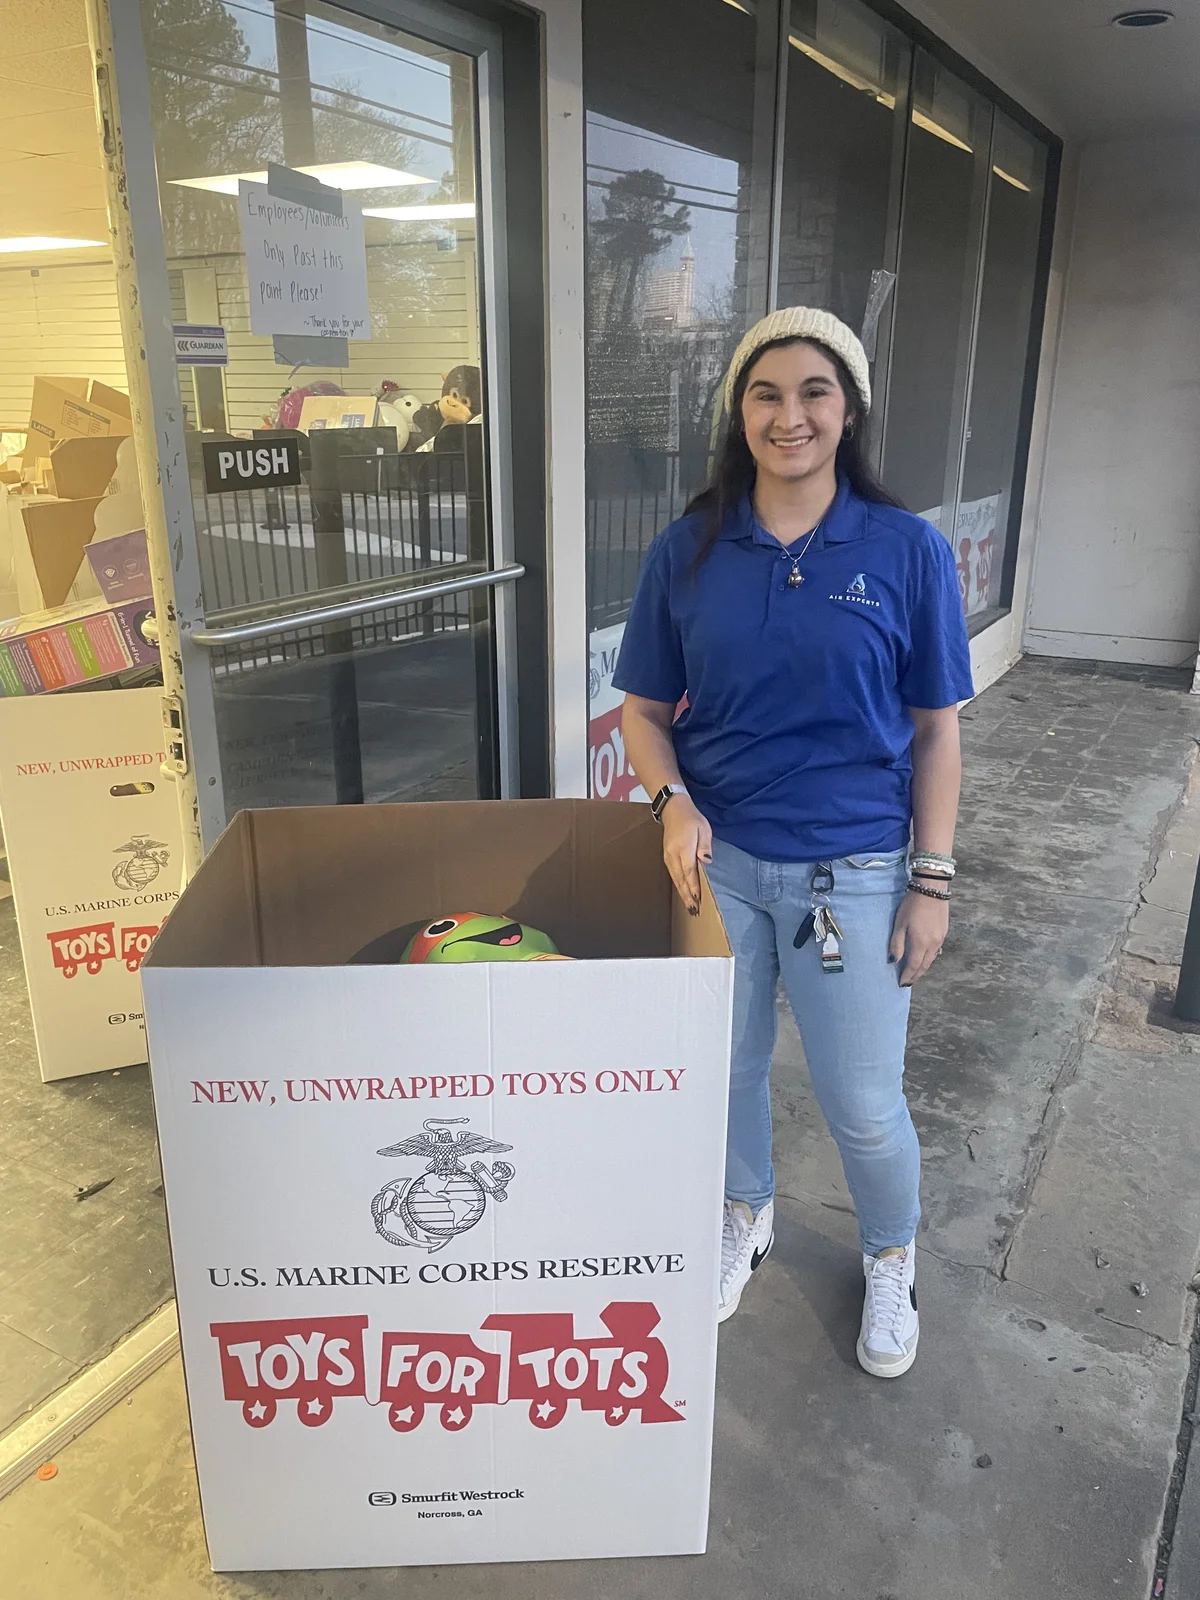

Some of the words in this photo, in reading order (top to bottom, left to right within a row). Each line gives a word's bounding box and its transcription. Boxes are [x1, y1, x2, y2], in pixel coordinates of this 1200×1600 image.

[264, 240, 285, 268] Only
[293, 244, 317, 267] Past
[323, 249, 343, 270] this
[290, 281, 323, 303] Please!
[328, 319, 339, 329] you
[342, 315, 350, 328] for
[218, 447, 290, 480] PUSH
[846, 595, 880, 607] EXPERTS
[16, 761, 56, 776] NEW,
[59, 752, 153, 773] UNWRAPPED
[45, 905, 71, 917] U.S.
[74, 897, 131, 914] MARINE
[134, 890, 180, 906] CORPS
[55, 931, 111, 961] TOYS
[124, 931, 156, 953] FO
[190, 1079, 276, 1106] NEW,
[283, 1074, 495, 1102] UNWRAPPED
[502, 1071, 587, 1096] TOYS
[595, 1068, 686, 1093] ONLY
[206, 1267, 267, 1287] U.S.
[275, 1264, 411, 1287] MARINE
[418, 1260, 529, 1284] CORPS
[537, 1253, 686, 1279] RESERVE
[226, 1331, 355, 1390] TOYS
[386, 1344, 486, 1397] FOR
[518, 1346, 649, 1399] TOTS
[401, 1491, 458, 1504] Smurfit
[459, 1488, 525, 1501] Westrock
[417, 1510, 465, 1519] Norcross,
[467, 1509, 483, 1517] GA
